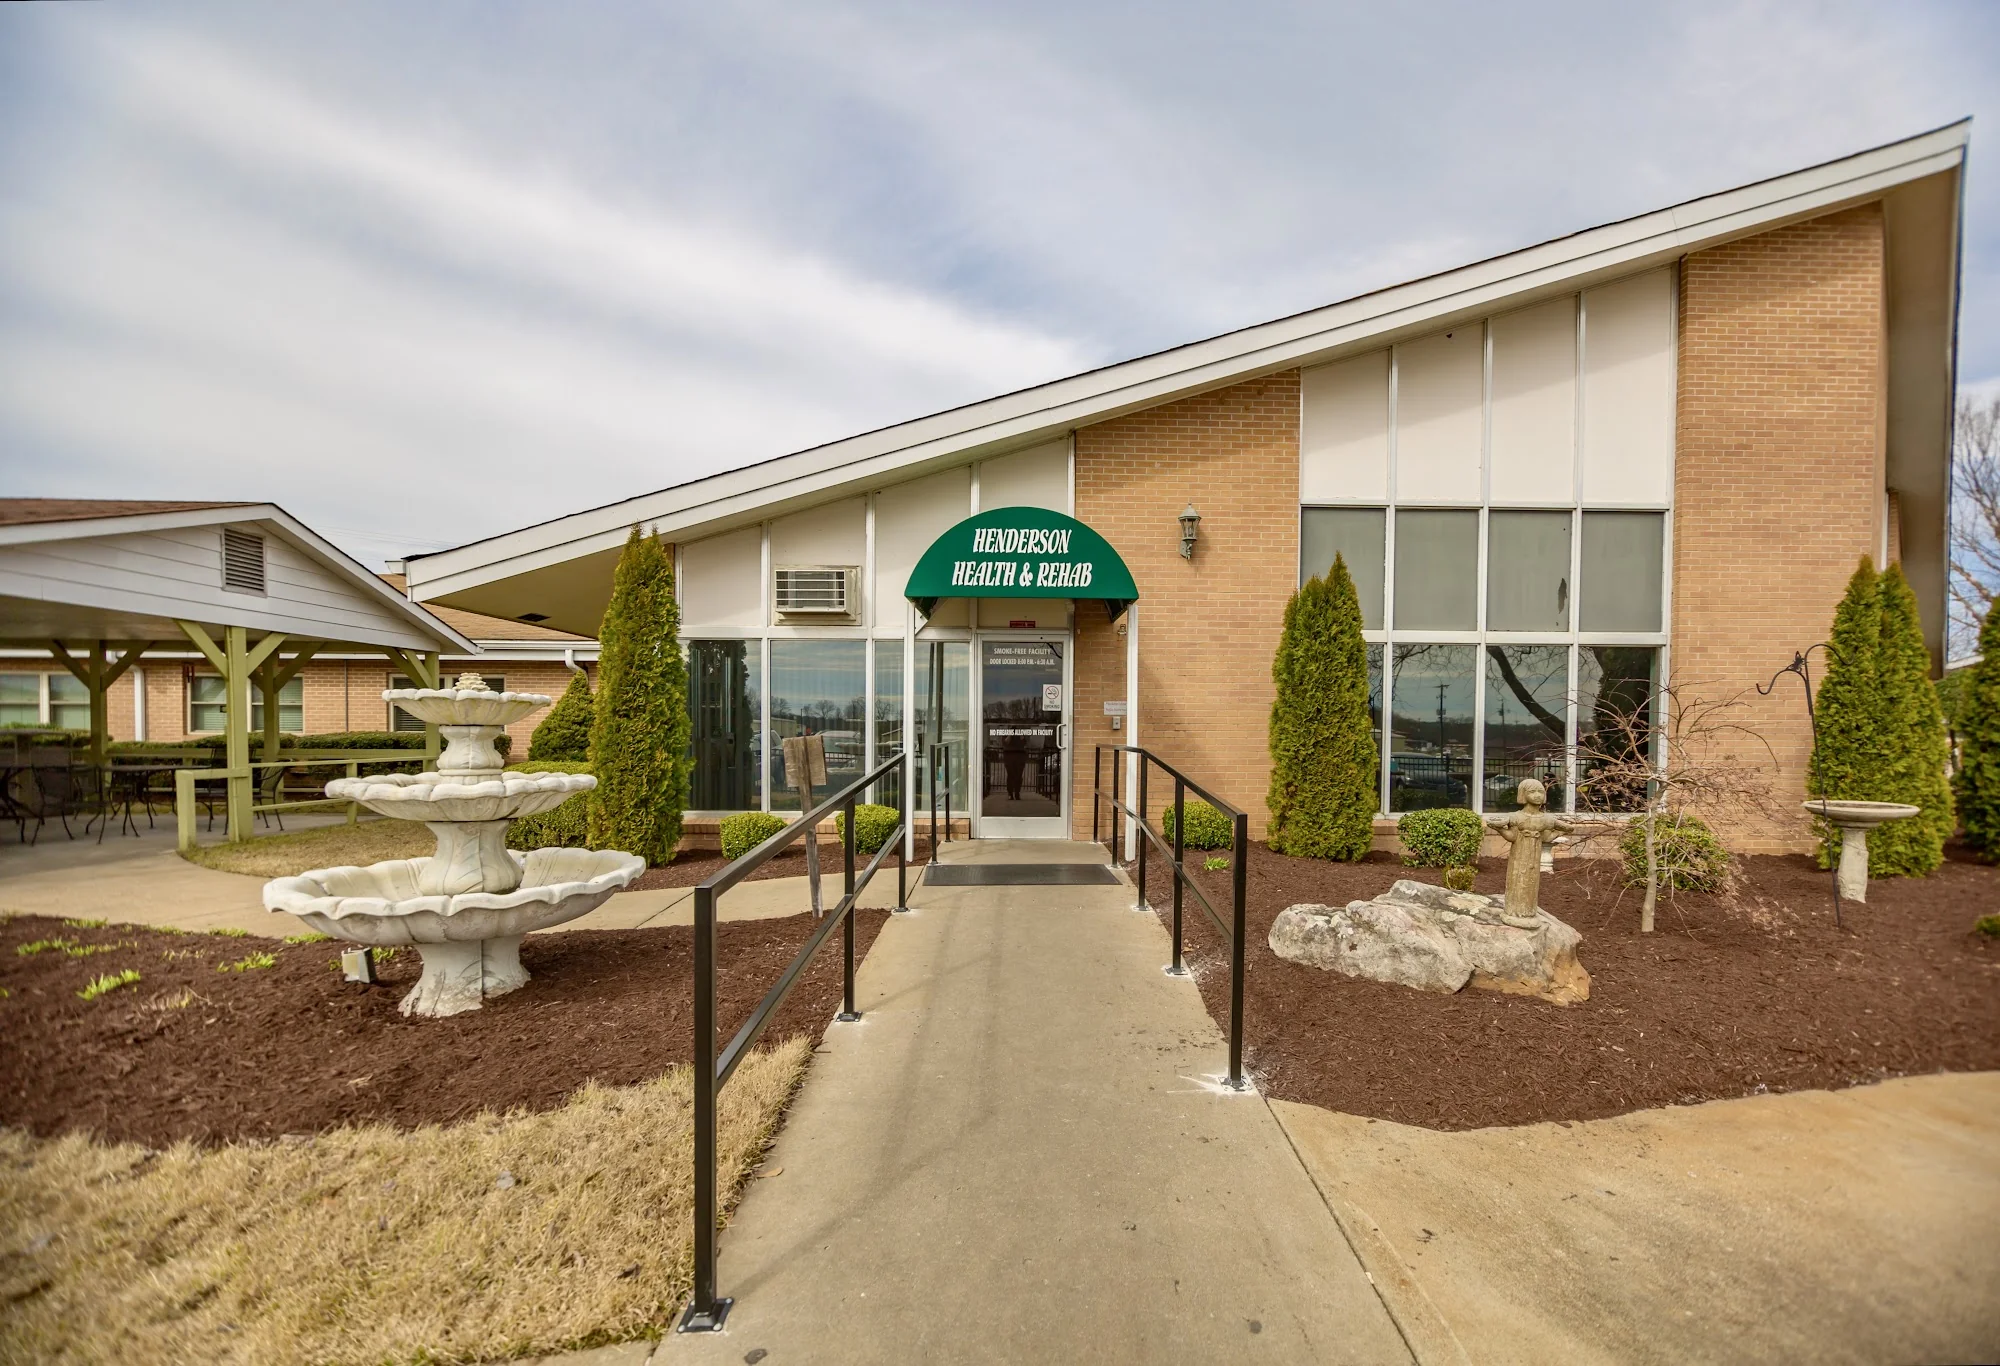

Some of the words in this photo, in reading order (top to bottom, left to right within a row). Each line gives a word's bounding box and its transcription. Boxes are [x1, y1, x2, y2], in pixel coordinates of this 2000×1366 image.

[973, 528, 1072, 554] HENDERSON
[952, 561, 1017, 586] HEALTH
[1019, 562, 1033, 587] &
[1037, 562, 1092, 587] REHAB
